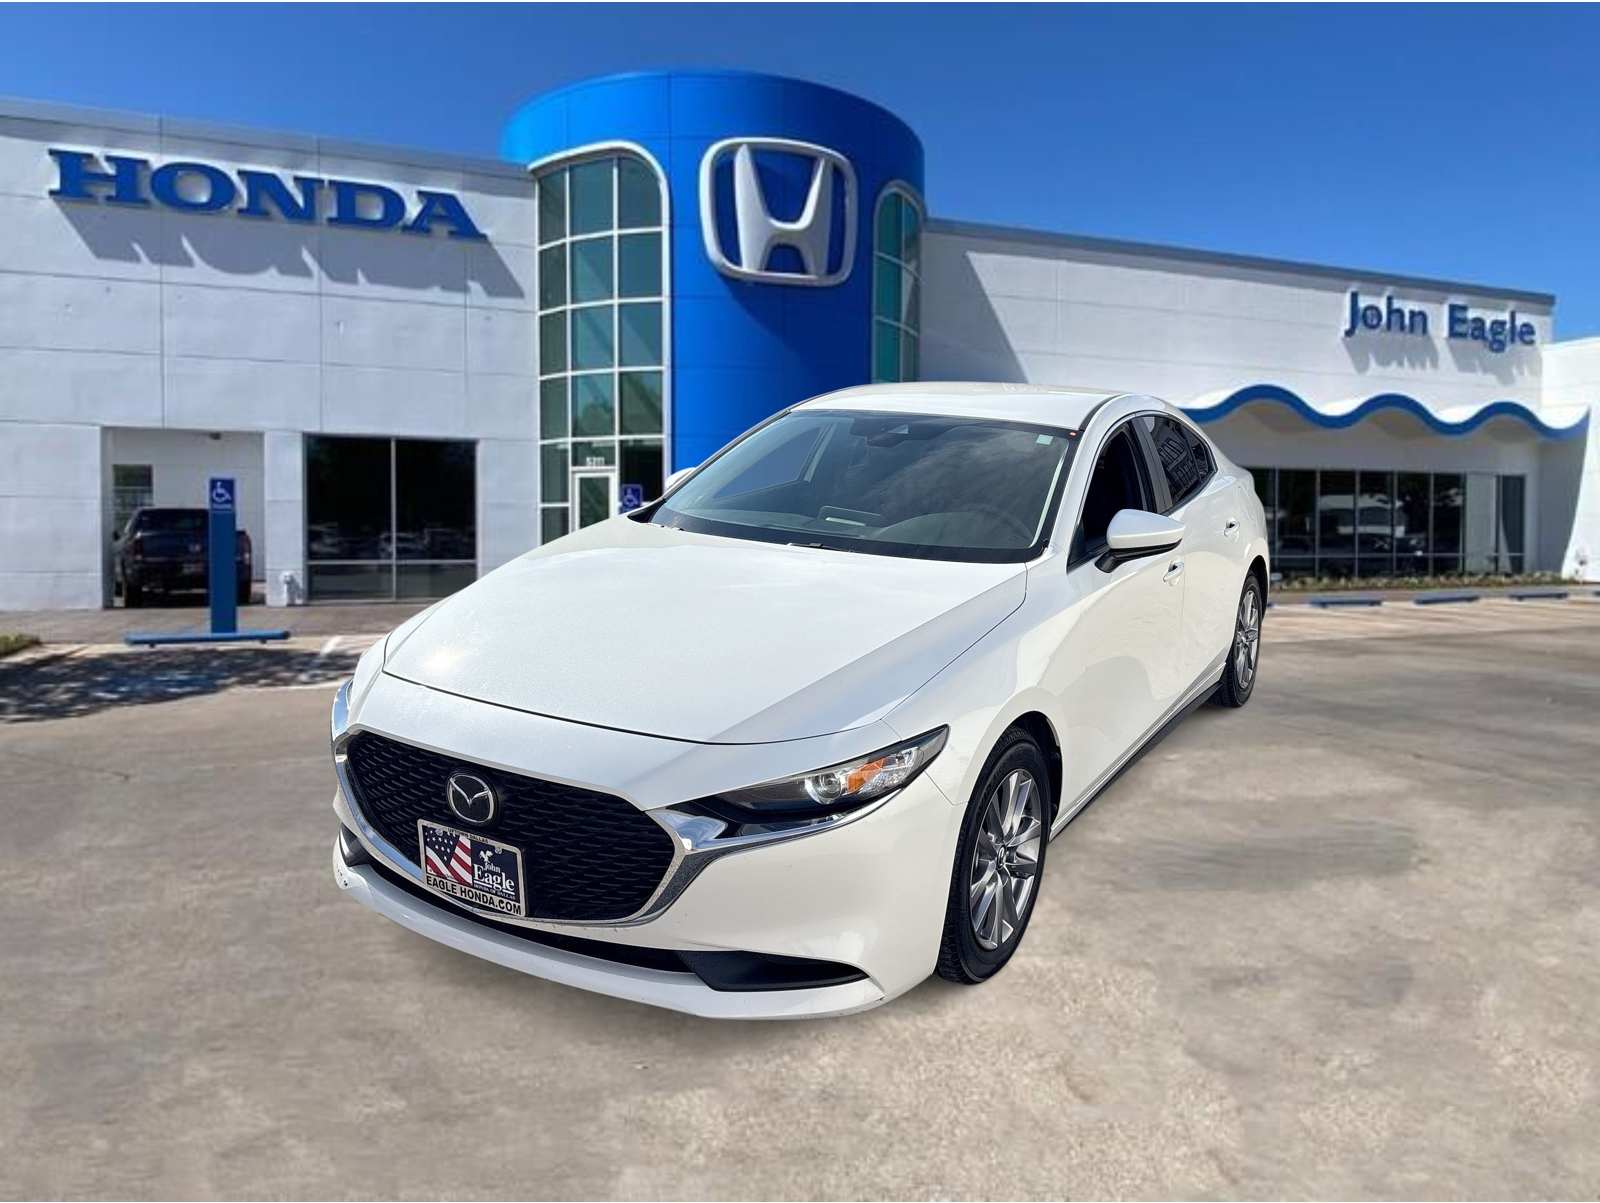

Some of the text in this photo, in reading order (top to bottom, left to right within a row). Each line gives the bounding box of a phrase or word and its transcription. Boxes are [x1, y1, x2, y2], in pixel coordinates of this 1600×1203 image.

[48, 148, 487, 240] HONDA
[1344, 290, 1536, 353] John Eagle
[473, 863, 515, 891] Eagle
[483, 862, 501, 873] John
[426, 875, 522, 915] EAGLE HONDA.COM
